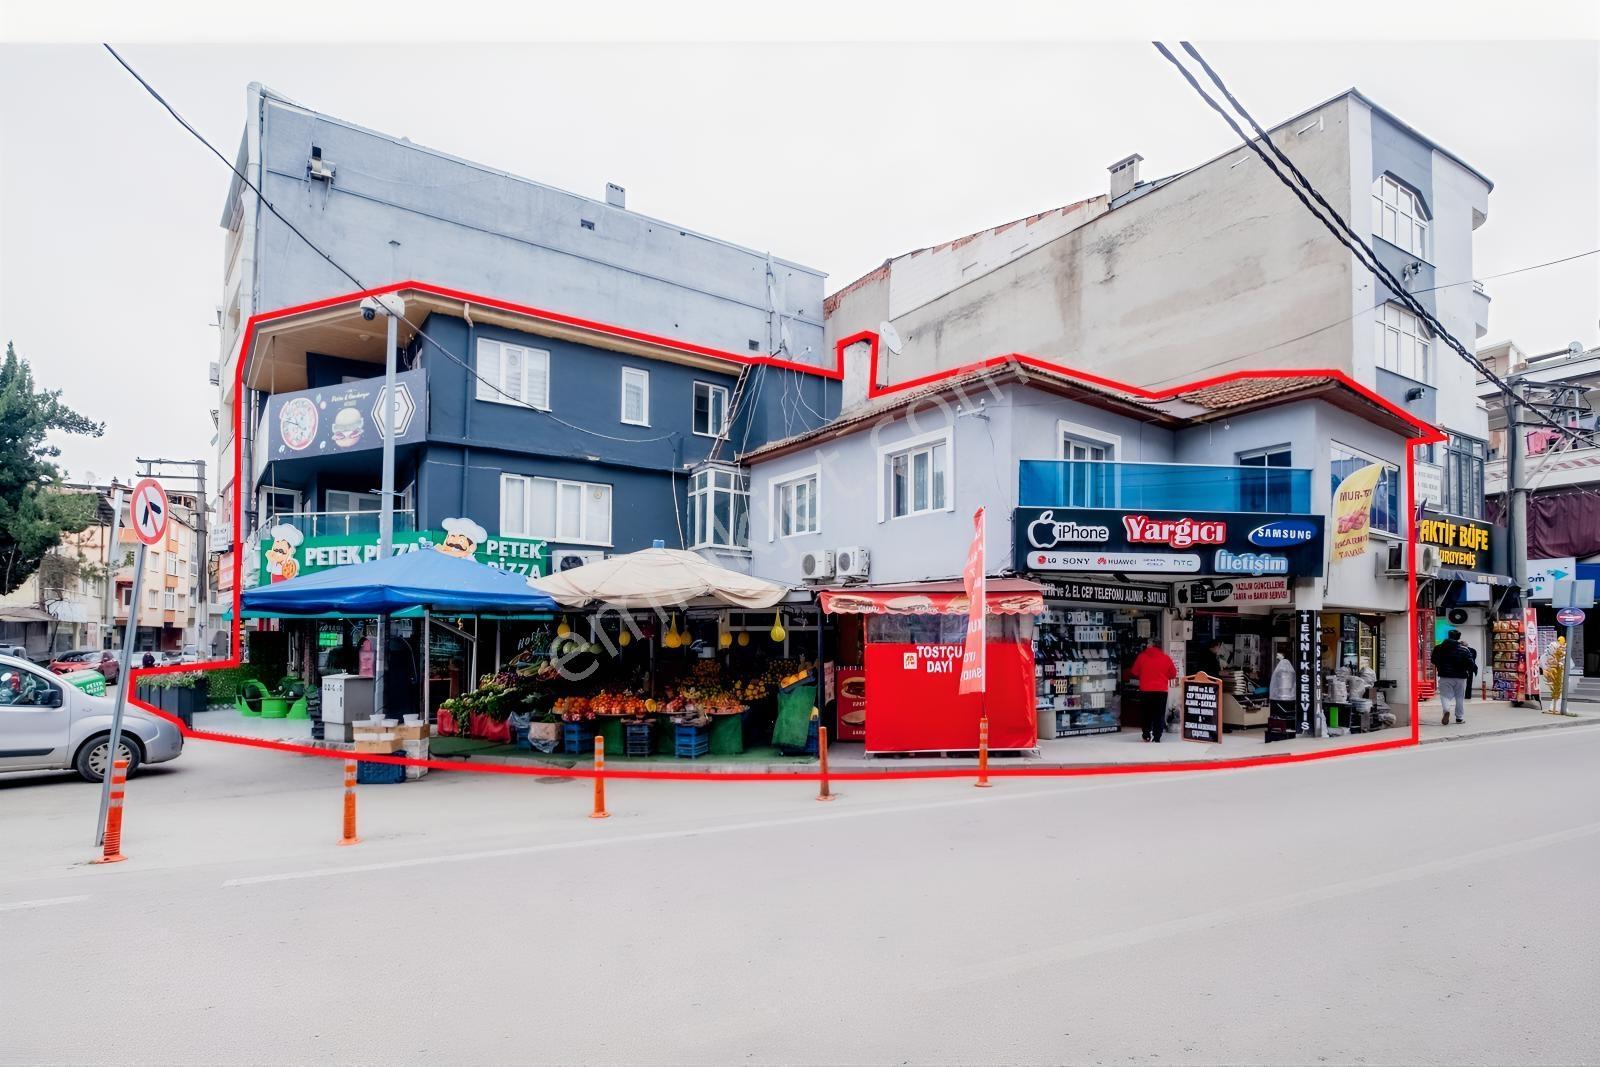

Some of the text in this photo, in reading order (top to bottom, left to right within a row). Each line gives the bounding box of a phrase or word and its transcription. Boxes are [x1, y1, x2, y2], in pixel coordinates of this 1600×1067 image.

[1058, 524, 1108, 540] iPhone
[1125, 517, 1225, 547] Yargıcı
[1257, 527, 1312, 540] SAMSUNG
[1459, 523, 1489, 551] BÜFE
[305, 546, 362, 567] PETEK
[486, 540, 542, 559] PETEK
[1062, 557, 1090, 565] SONY
[1072, 585, 1081, 598] EL
[1081, 586, 1094, 599] CEP
[917, 645, 963, 662] TOSTÇU
